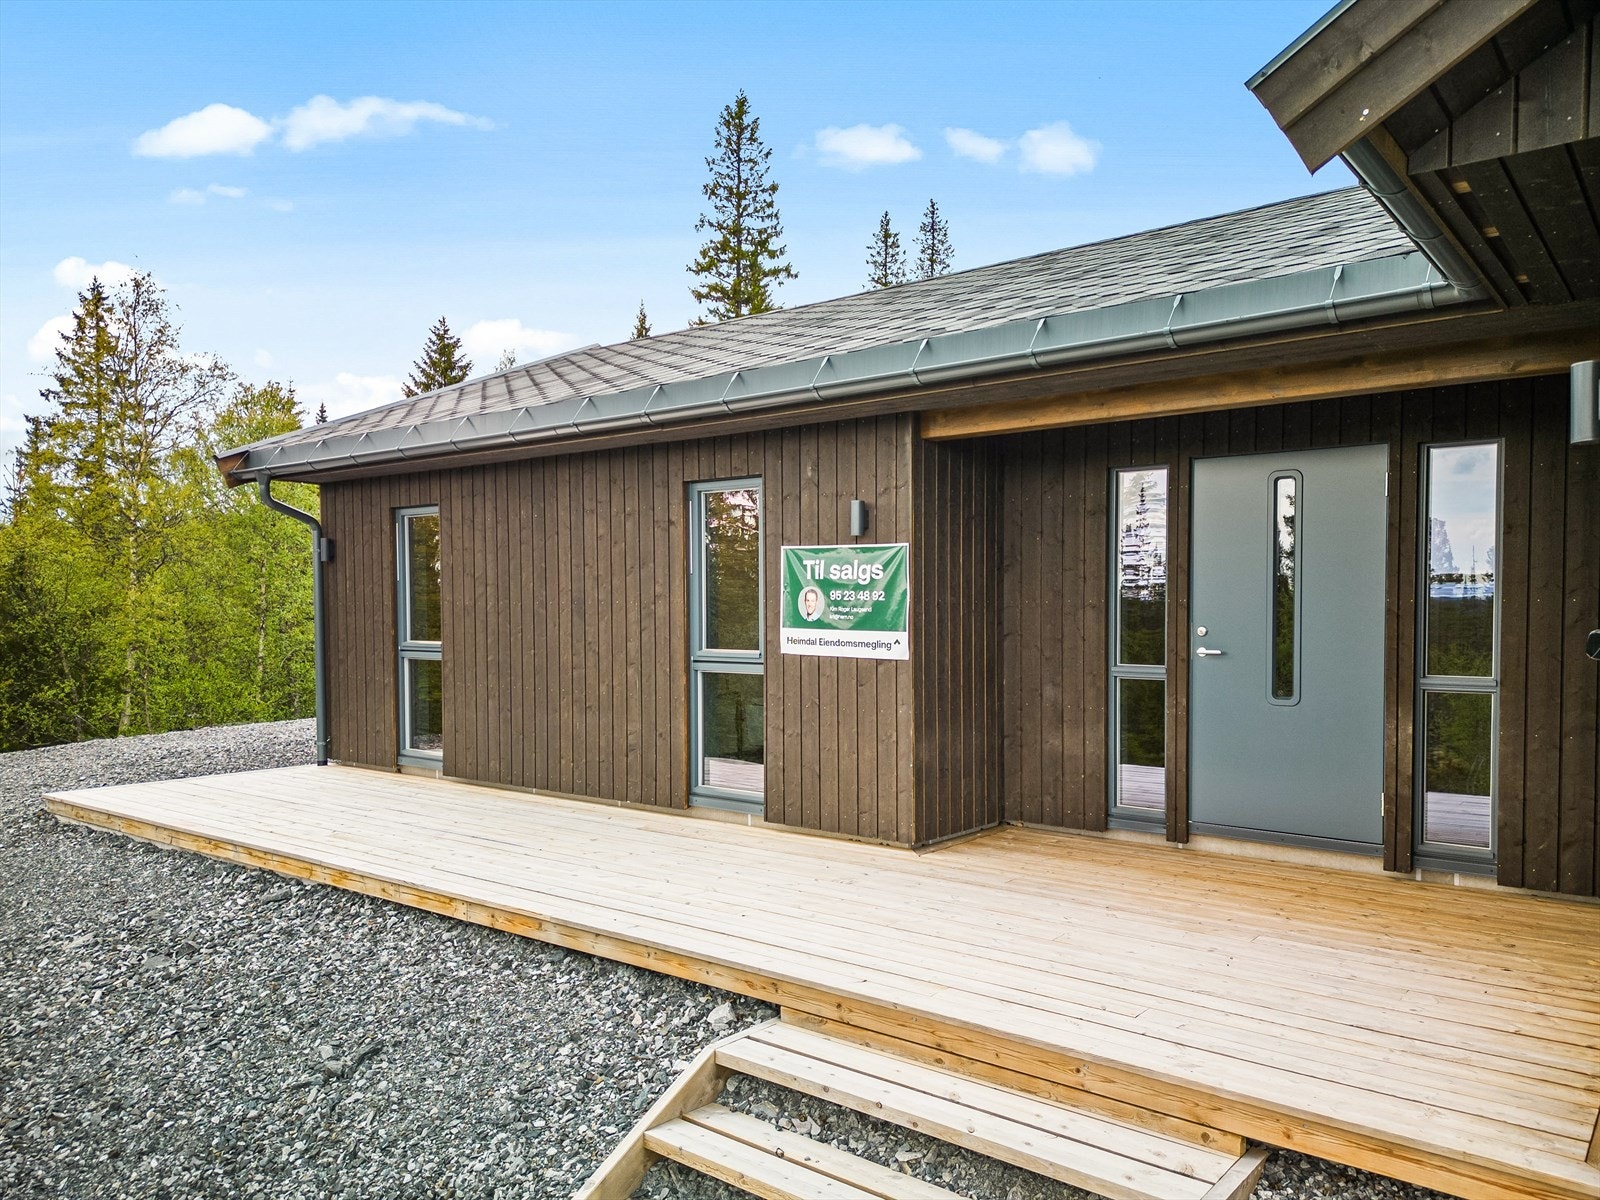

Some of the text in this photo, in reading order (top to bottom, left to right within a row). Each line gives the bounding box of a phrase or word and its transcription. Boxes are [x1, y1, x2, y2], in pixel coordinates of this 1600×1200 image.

[803, 560, 884, 585] Til salgs
[829, 590, 885, 601] 95 23 48 92
[786, 636, 892, 651] Heimdal Eiendomsmegling
